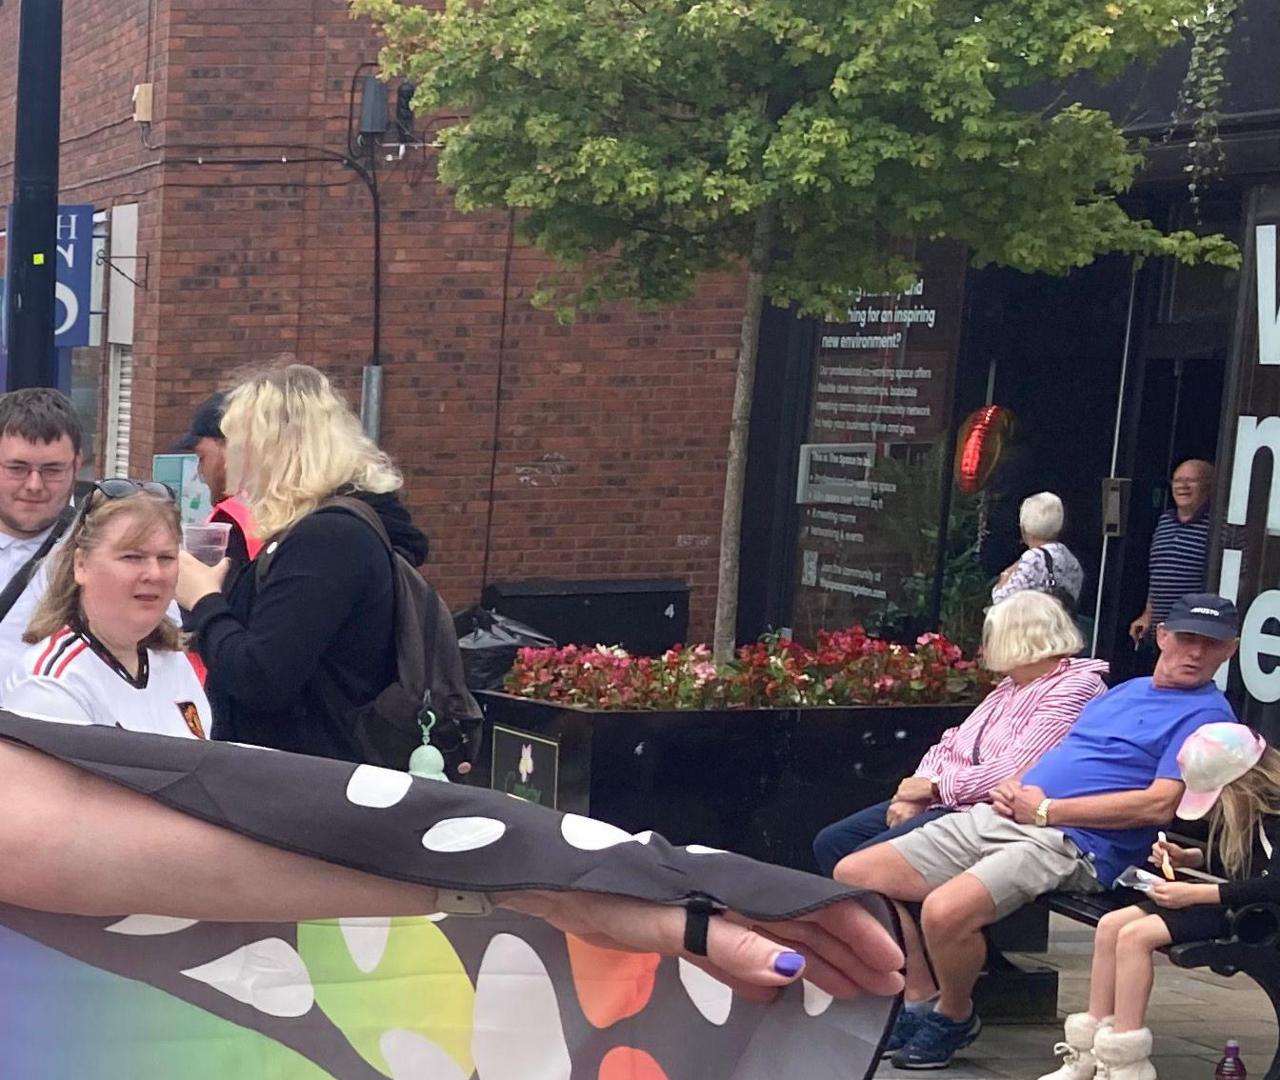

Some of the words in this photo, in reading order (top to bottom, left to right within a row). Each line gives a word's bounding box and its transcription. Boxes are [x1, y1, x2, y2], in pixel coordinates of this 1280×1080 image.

[867, 306, 880, 322] for
[880, 309, 893, 322] an
[894, 305, 936, 328] inspiring
[822, 335, 839, 348] new
[840, 332, 902, 349] environment?
